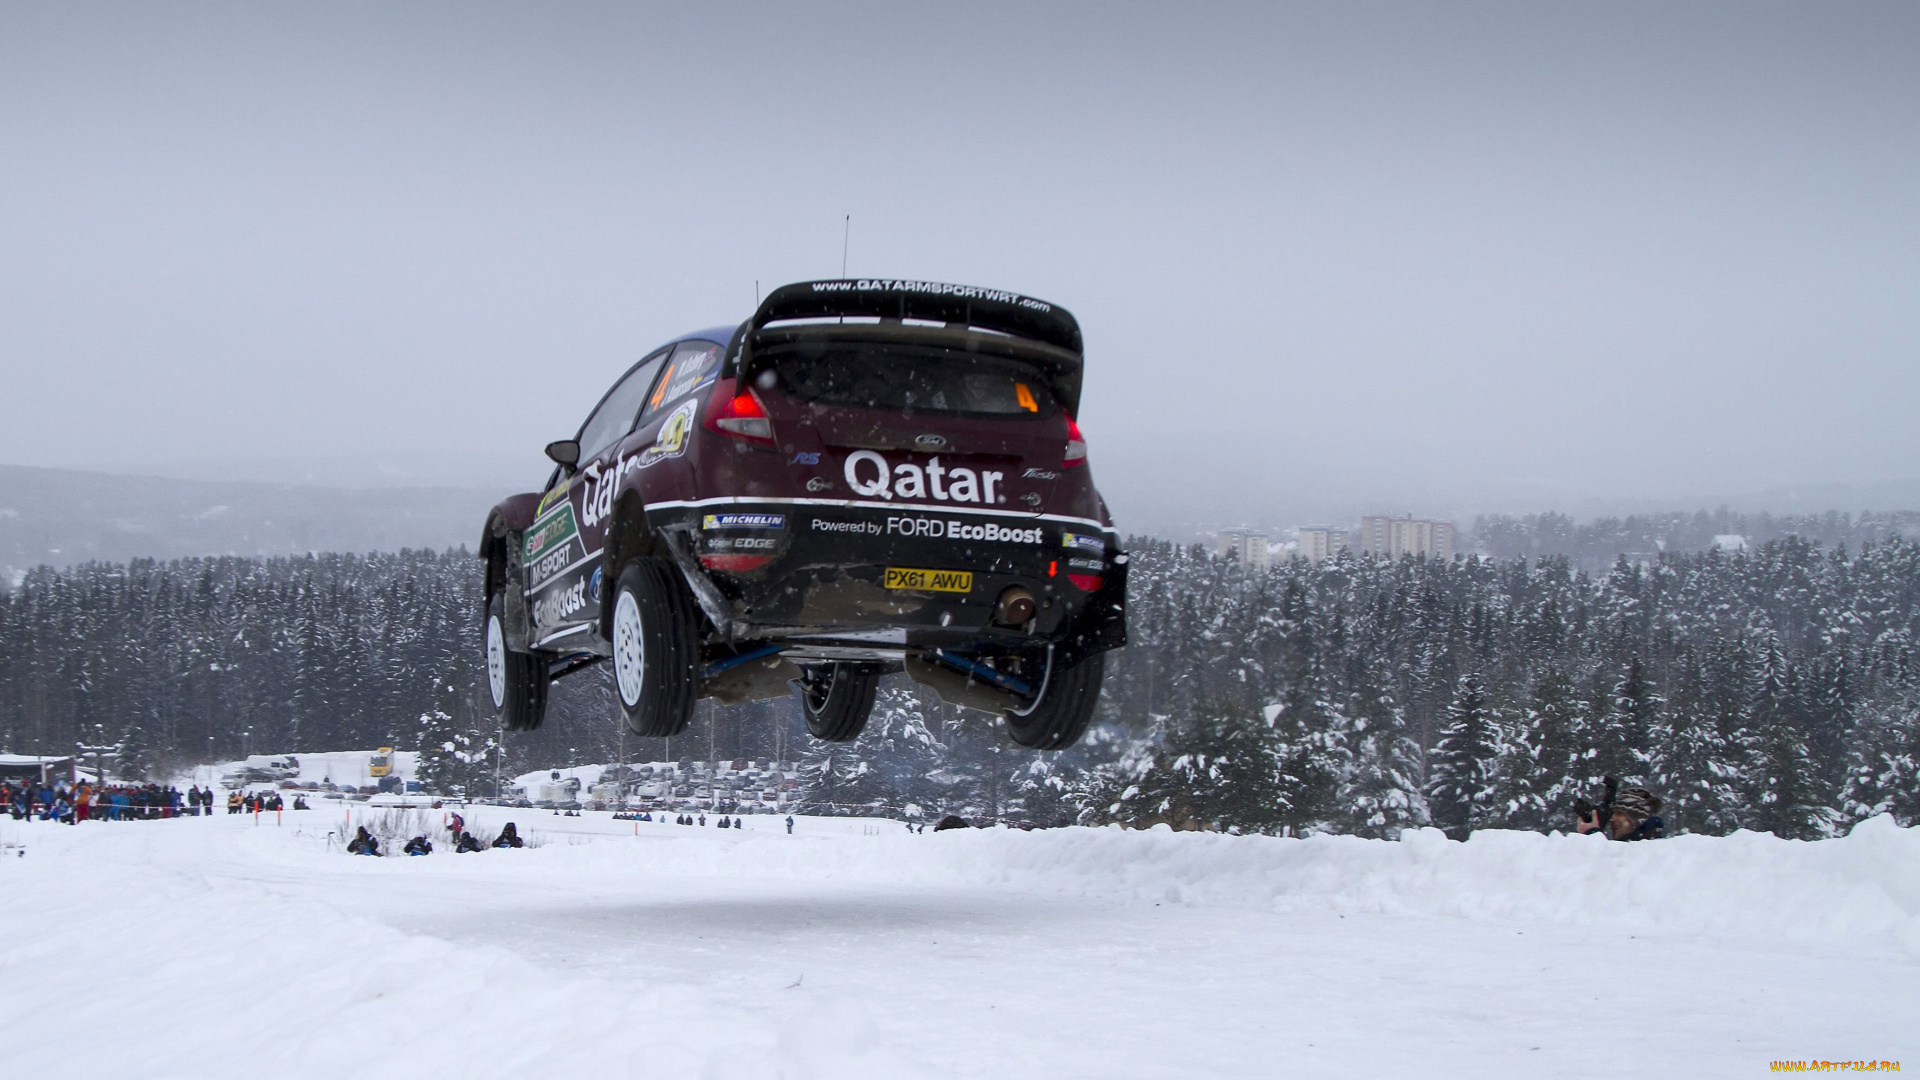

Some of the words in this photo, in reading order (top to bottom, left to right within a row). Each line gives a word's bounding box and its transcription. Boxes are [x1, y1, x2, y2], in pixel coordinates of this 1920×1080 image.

[812, 279, 1051, 313] www.QATARMSPORTWRT.com
[650, 363, 676, 413] 4
[1015, 382, 1039, 413] 4
[792, 451, 822, 466] RS
[843, 449, 1004, 504] Qatar
[721, 515, 783, 525] MICHELIN
[811, 518, 865, 533] Powered
[867, 520, 883, 536] by
[886, 516, 945, 538] FORD
[947, 520, 1044, 544] EcoBoost
[734, 538, 776, 549] EDGE
[532, 543, 571, 585] M-SPORT
[886, 570, 925, 587] PX61
[930, 572, 972, 590] AWU
